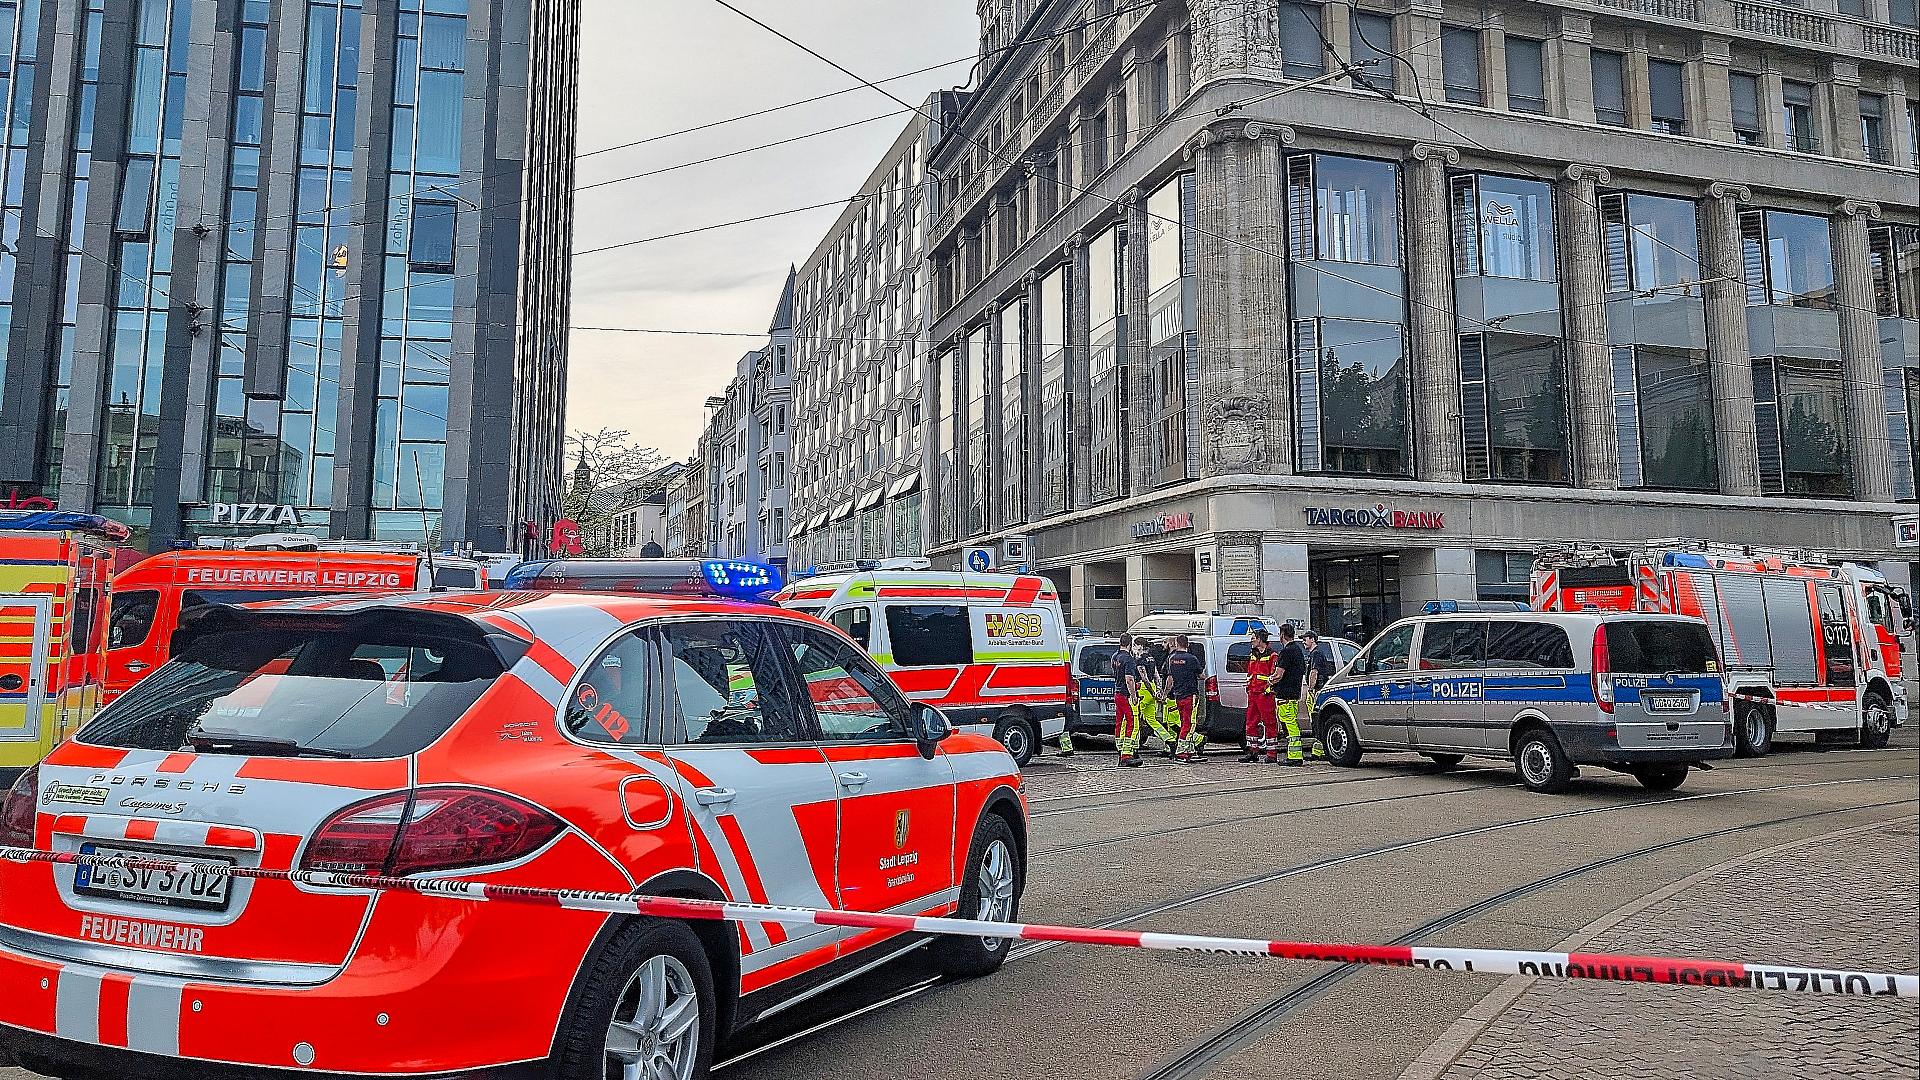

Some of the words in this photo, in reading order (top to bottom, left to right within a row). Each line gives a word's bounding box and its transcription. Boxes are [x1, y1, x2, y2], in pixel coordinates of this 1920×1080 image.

[212, 502, 297, 525] PIZZA
[187, 567, 317, 584] FEUERWEHR
[322, 571, 400, 587] LEIPZIG
[1000, 612, 1042, 638] ASB
[1833, 625, 1850, 646] 112
[1086, 687, 1114, 696] POLIZEI
[1431, 682, 1482, 698] POLIZEI
[1614, 677, 1649, 688] POLIZEI
[595, 702, 629, 741] 112
[91, 774, 246, 795] PORSCHE
[119, 797, 173, 813] Cayenne
[898, 850, 918, 866] Leipzig
[80, 914, 205, 952] FEUERWEHR
